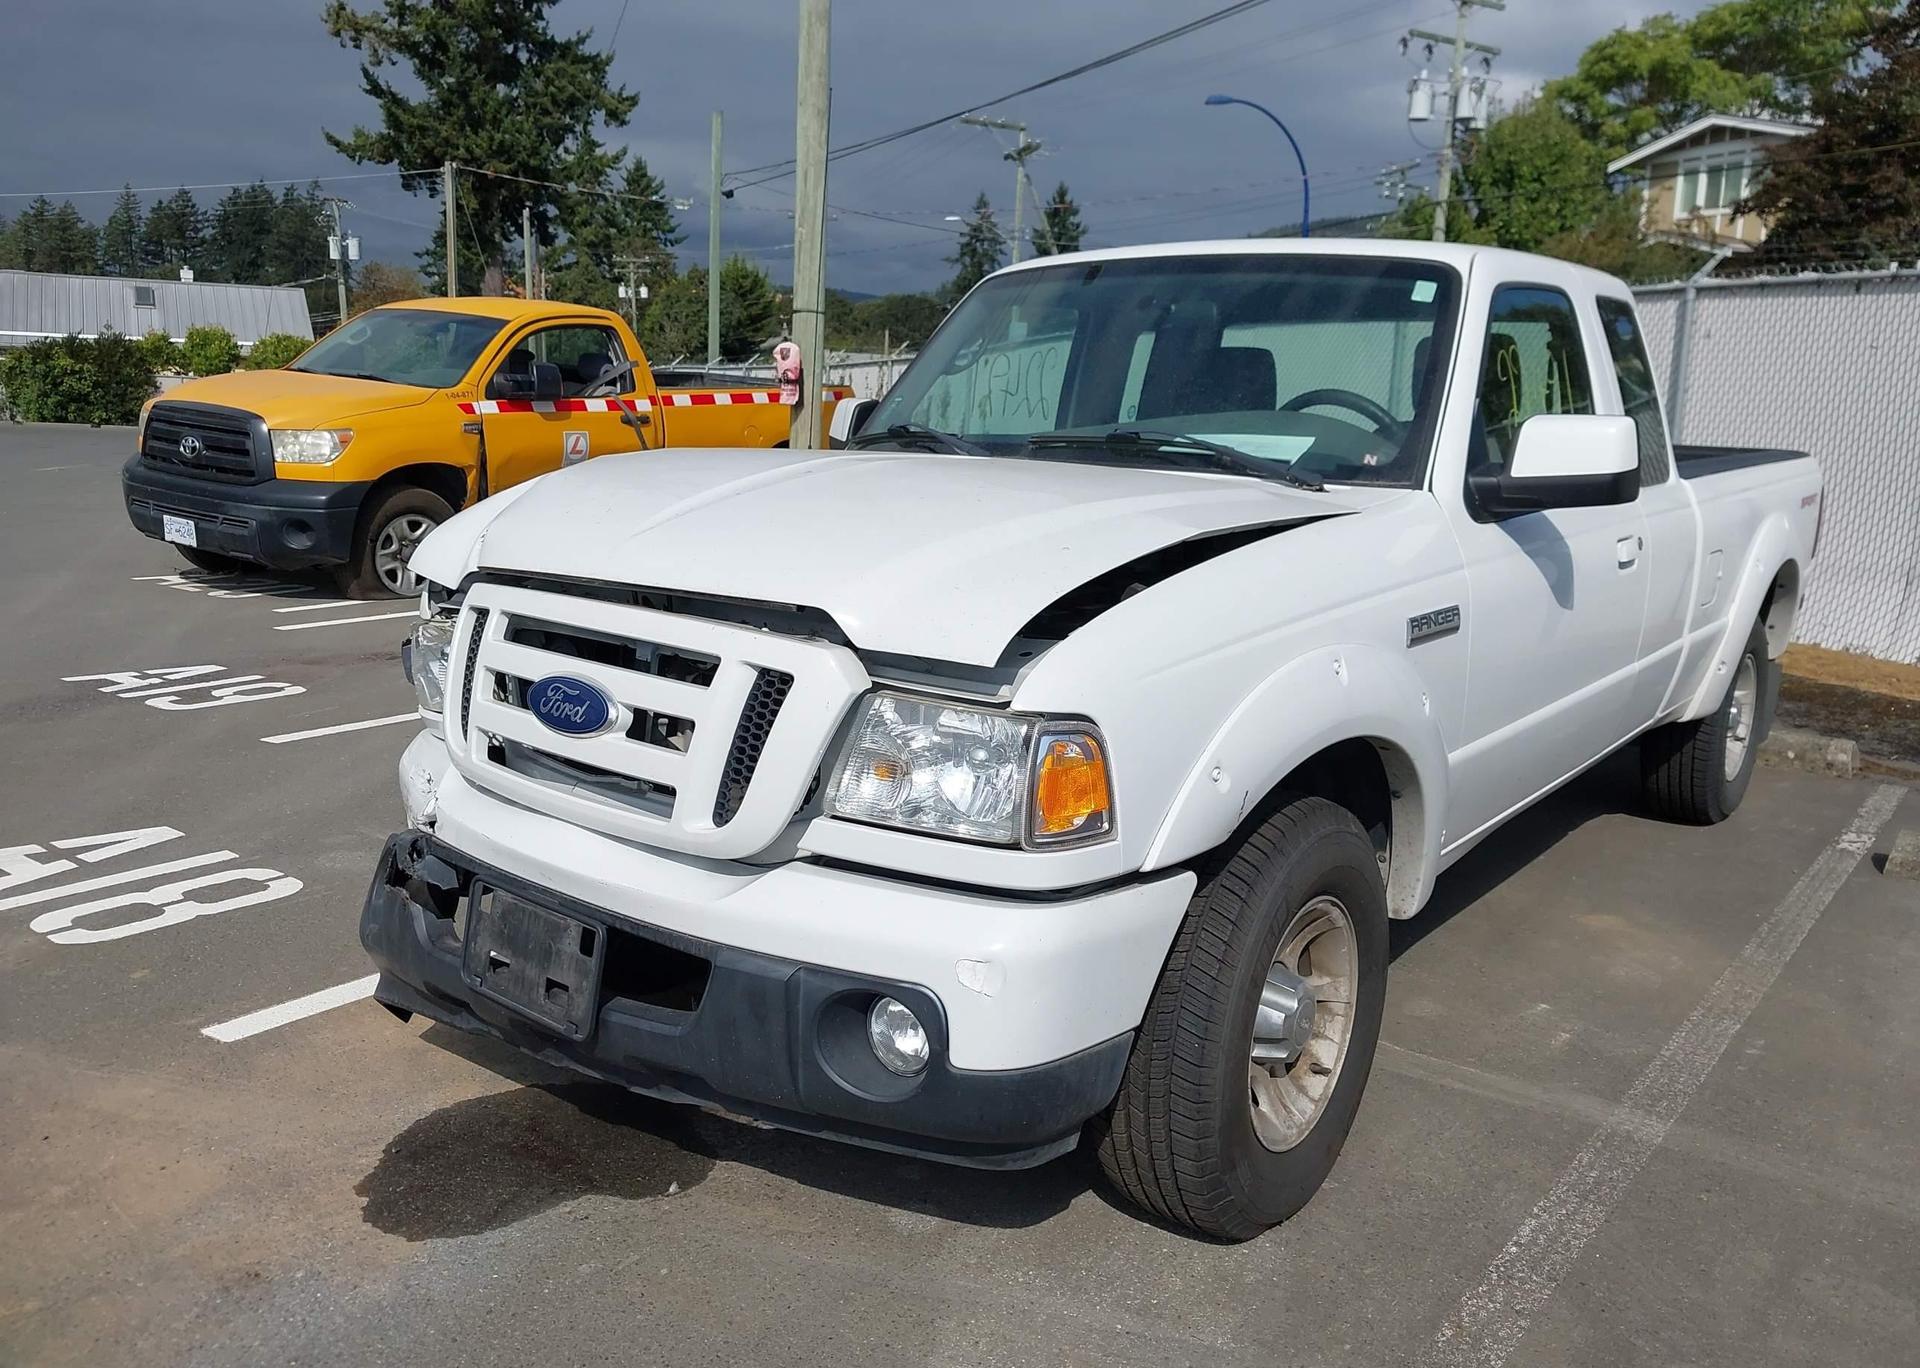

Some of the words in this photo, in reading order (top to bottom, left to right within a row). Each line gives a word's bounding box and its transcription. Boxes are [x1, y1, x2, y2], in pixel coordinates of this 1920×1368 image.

[1410, 607, 1460, 634] RANGER
[60, 664, 307, 710] A19
[540, 683, 591, 723] Ford
[0, 826, 304, 945] A18
